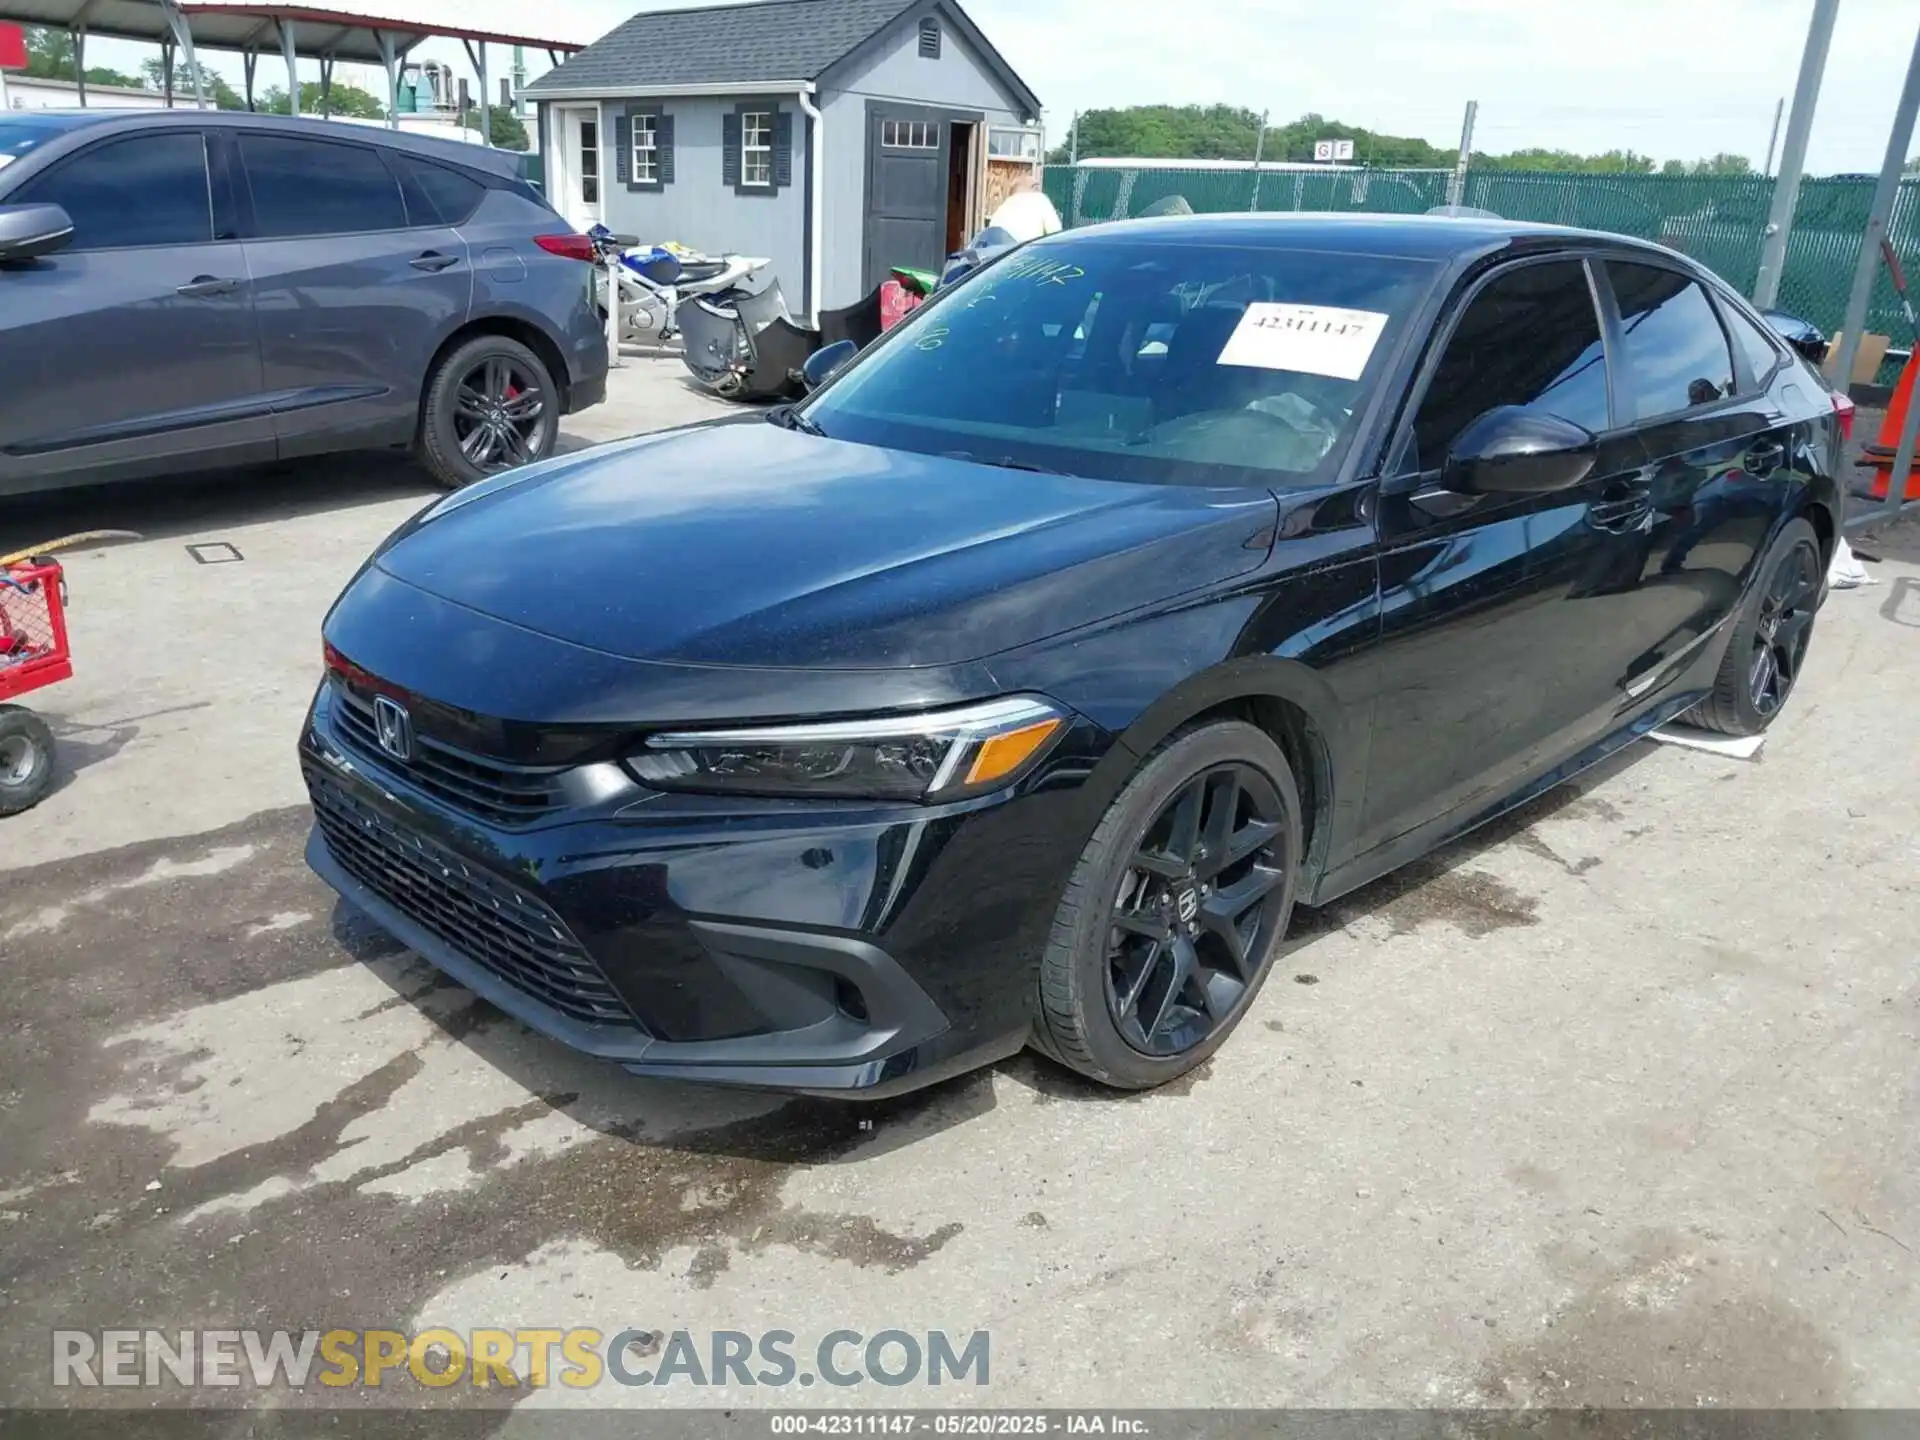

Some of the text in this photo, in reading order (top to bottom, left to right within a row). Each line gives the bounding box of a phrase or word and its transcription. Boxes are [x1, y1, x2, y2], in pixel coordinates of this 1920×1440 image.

[1318, 144, 1329, 158] G
[1340, 143, 1351, 157] F
[1252, 316, 1364, 336] 42311147
